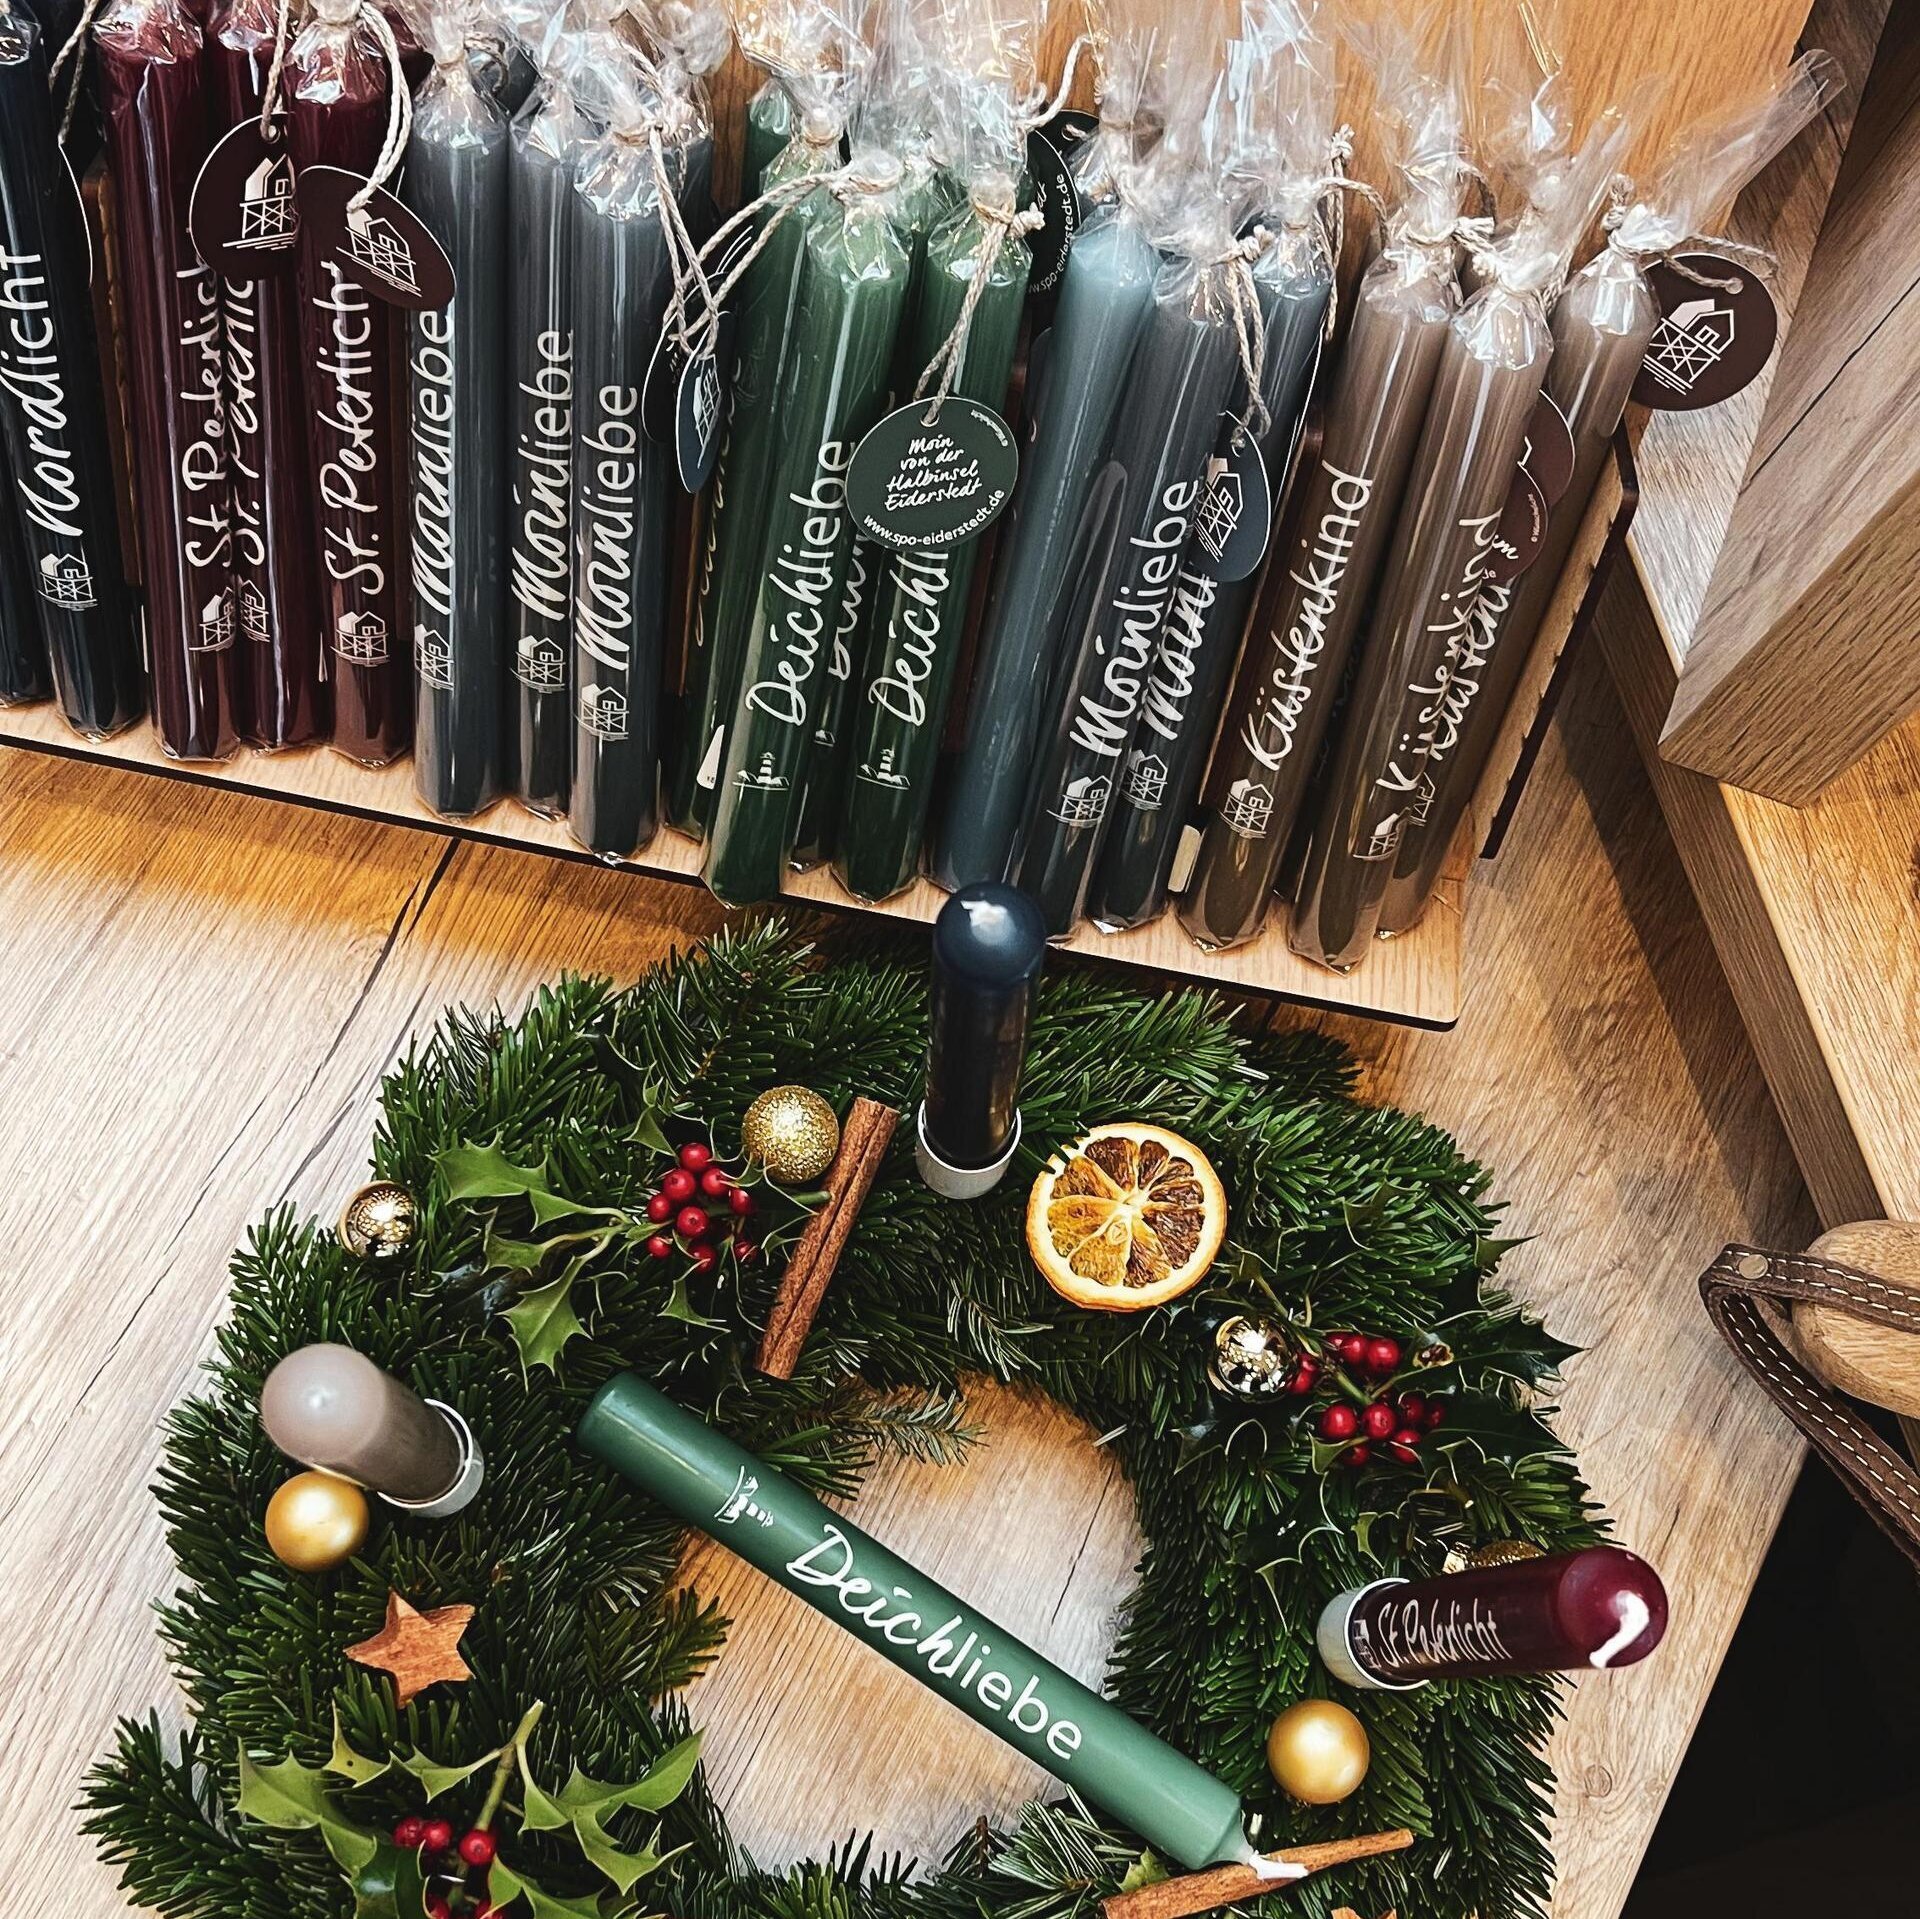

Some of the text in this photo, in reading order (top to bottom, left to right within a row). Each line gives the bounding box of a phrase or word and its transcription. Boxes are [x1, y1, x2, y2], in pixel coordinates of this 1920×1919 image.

[510, 329, 575, 621] Moinliebe
[886, 459, 978, 492] Halbinsel
[901, 449, 964, 471] von der
[908, 434, 954, 455] Moin
[575, 384, 638, 672] Moinliebe
[863, 489, 1005, 546] www.spo-eiderstedt.de
[885, 477, 983, 511] Eiderstedt
[325, 527, 386, 597] St.
[745, 440, 855, 726] Deichliebe
[1069, 478, 1199, 757] Moinliebe
[1241, 459, 1373, 771] Küstenkind
[786, 1524, 1082, 1759] Deichliebe
[1377, 1598, 1513, 1668] St. Peterlicht
